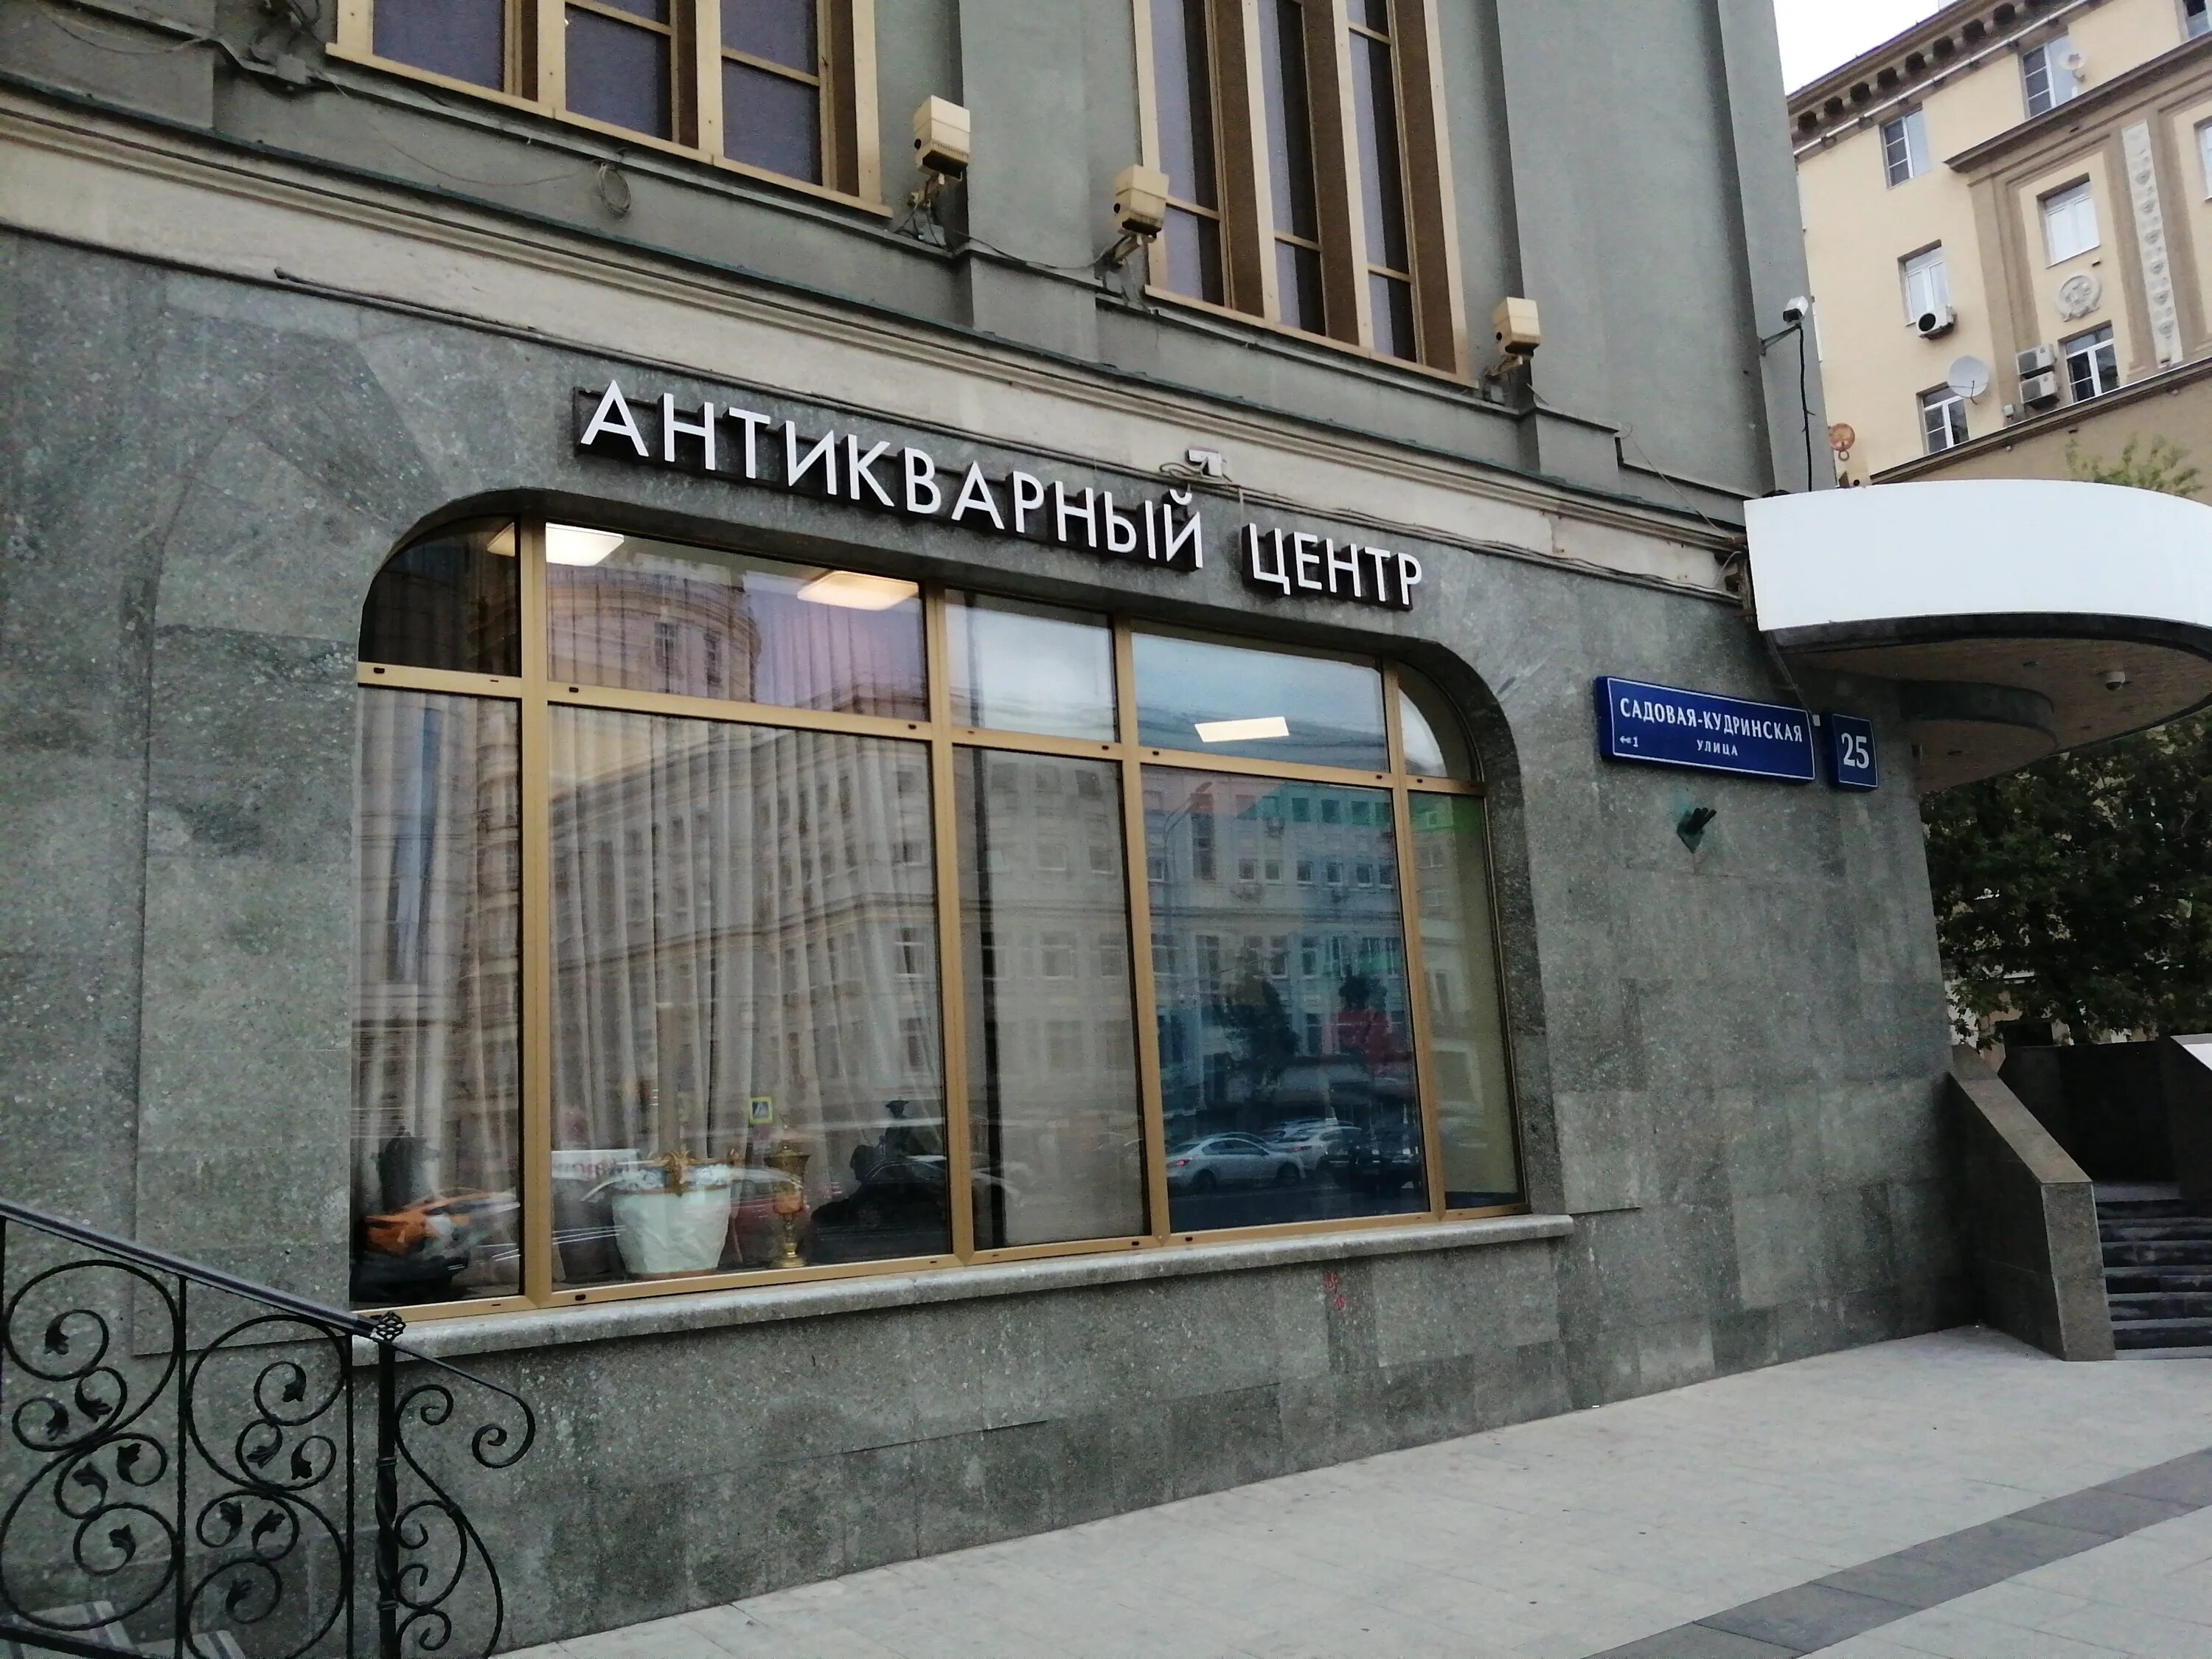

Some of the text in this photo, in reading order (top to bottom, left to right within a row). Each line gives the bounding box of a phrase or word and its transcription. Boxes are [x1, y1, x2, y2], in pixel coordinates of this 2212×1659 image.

[580, 380, 1422, 605] АНТИКВАРНЫЙ ЦЕНТР
[1620, 698, 1804, 742] САДОВАЯ-КУДРИНСКАЯ
[1697, 739, 1738, 757] УЛИЦА
[1841, 732, 1869, 769] 25
